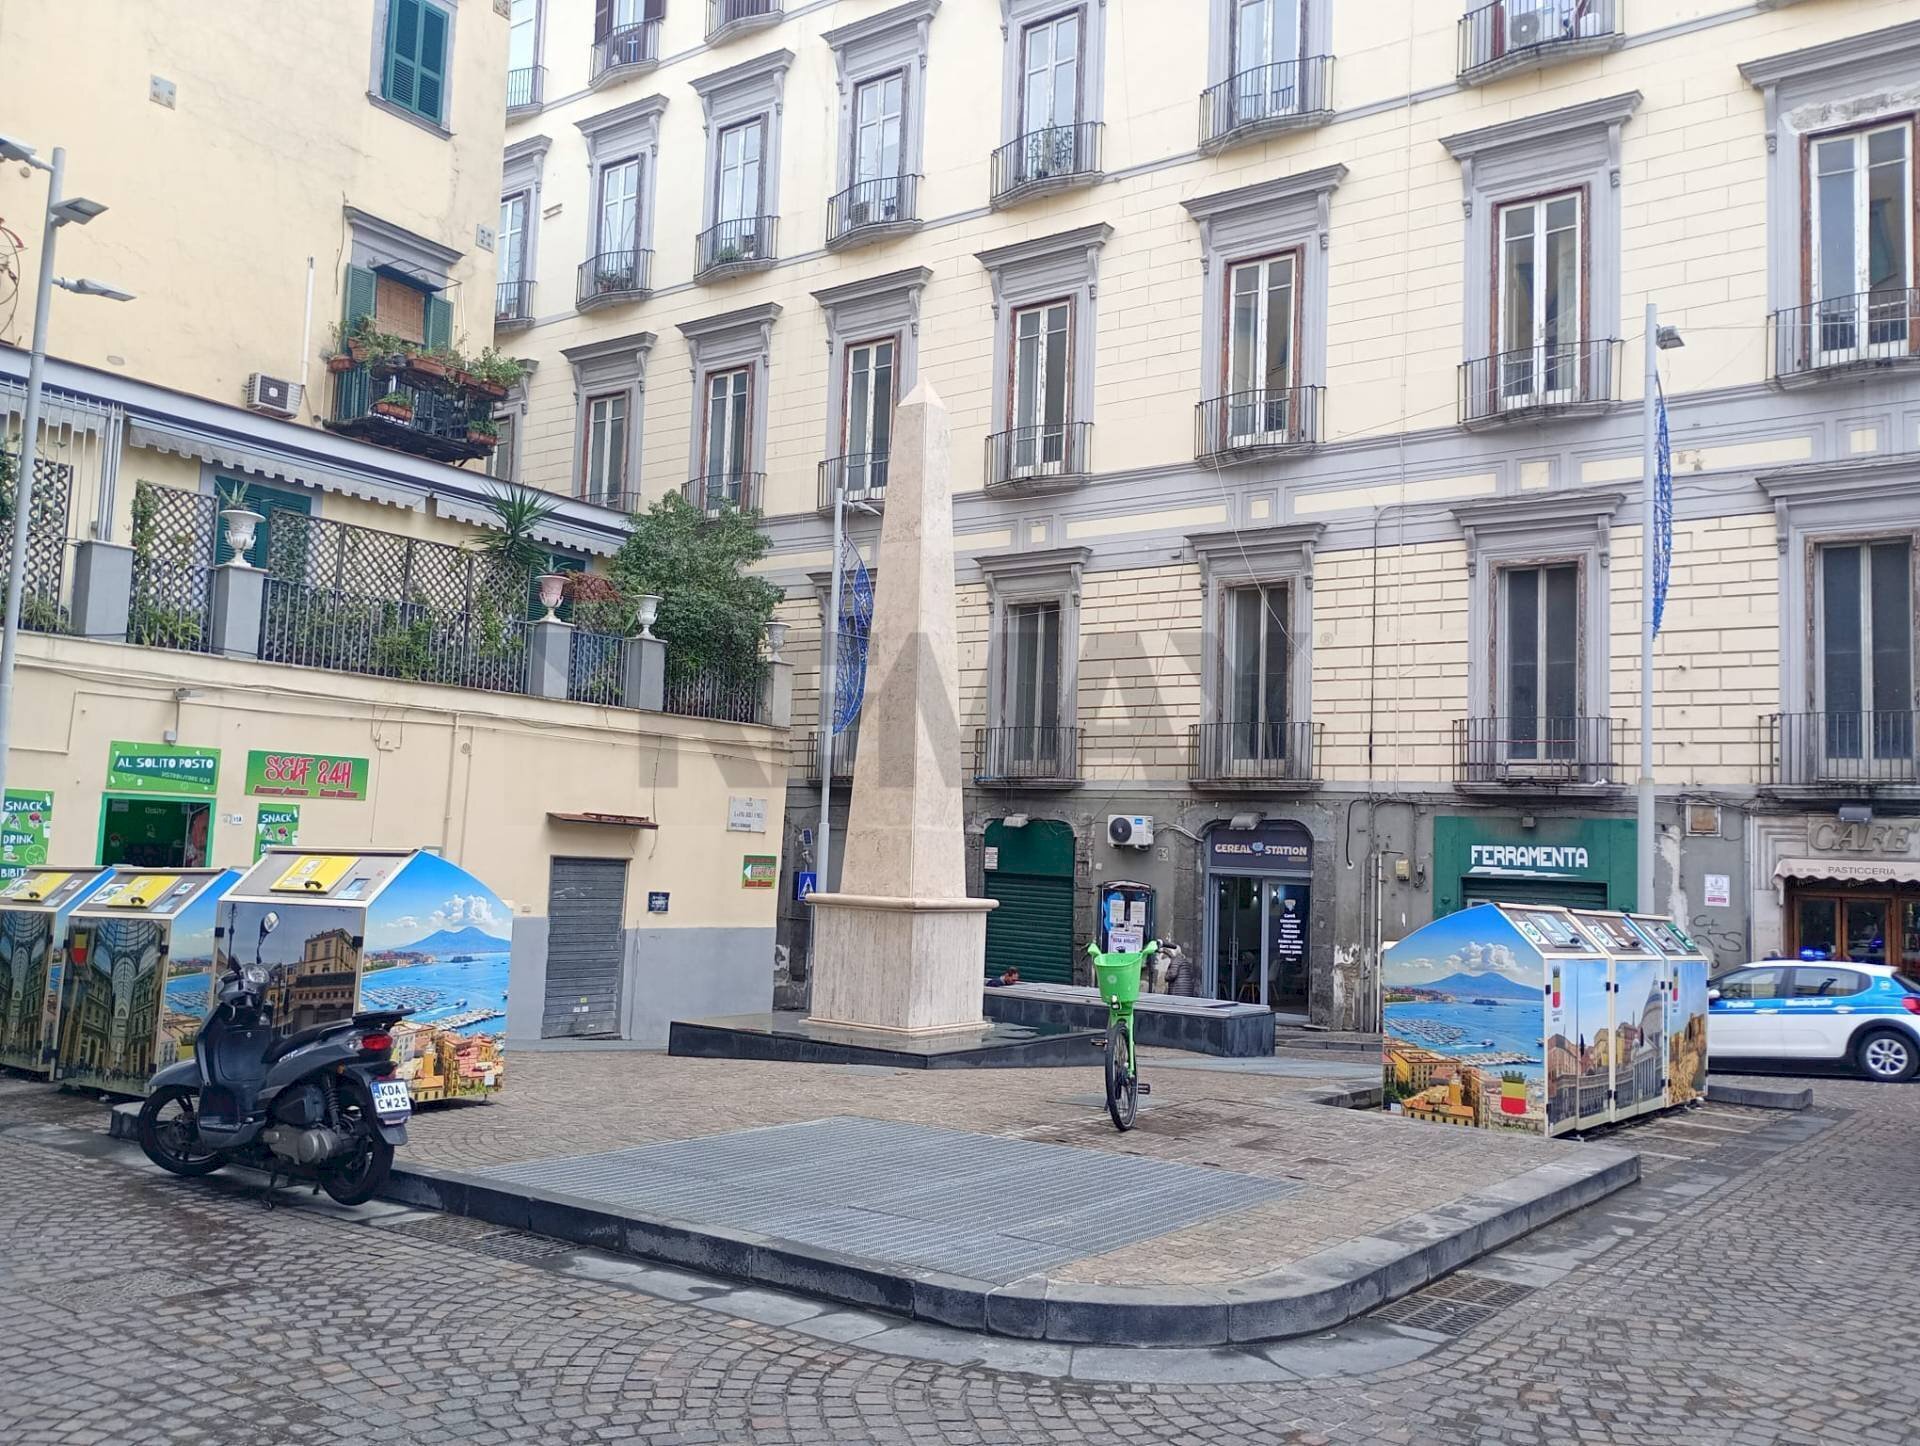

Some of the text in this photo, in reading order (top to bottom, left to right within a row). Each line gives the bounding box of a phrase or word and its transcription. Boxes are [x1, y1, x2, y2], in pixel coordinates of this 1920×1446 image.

[117, 757, 214, 769] AL SOLITO POSTO
[265, 755, 352, 789] SELF 24H
[4, 801, 44, 811] SNACK
[261, 813, 292, 823] SNACK
[3, 834, 34, 845] DRINK
[1214, 843, 1308, 856] CEREAL STATION
[1470, 844, 1589, 868] FERRAMENTA
[0, 867, 28, 878] BIBIT
[1827, 865, 1896, 876] PASTICCERIA
[380, 1085, 401, 1096] KDA
